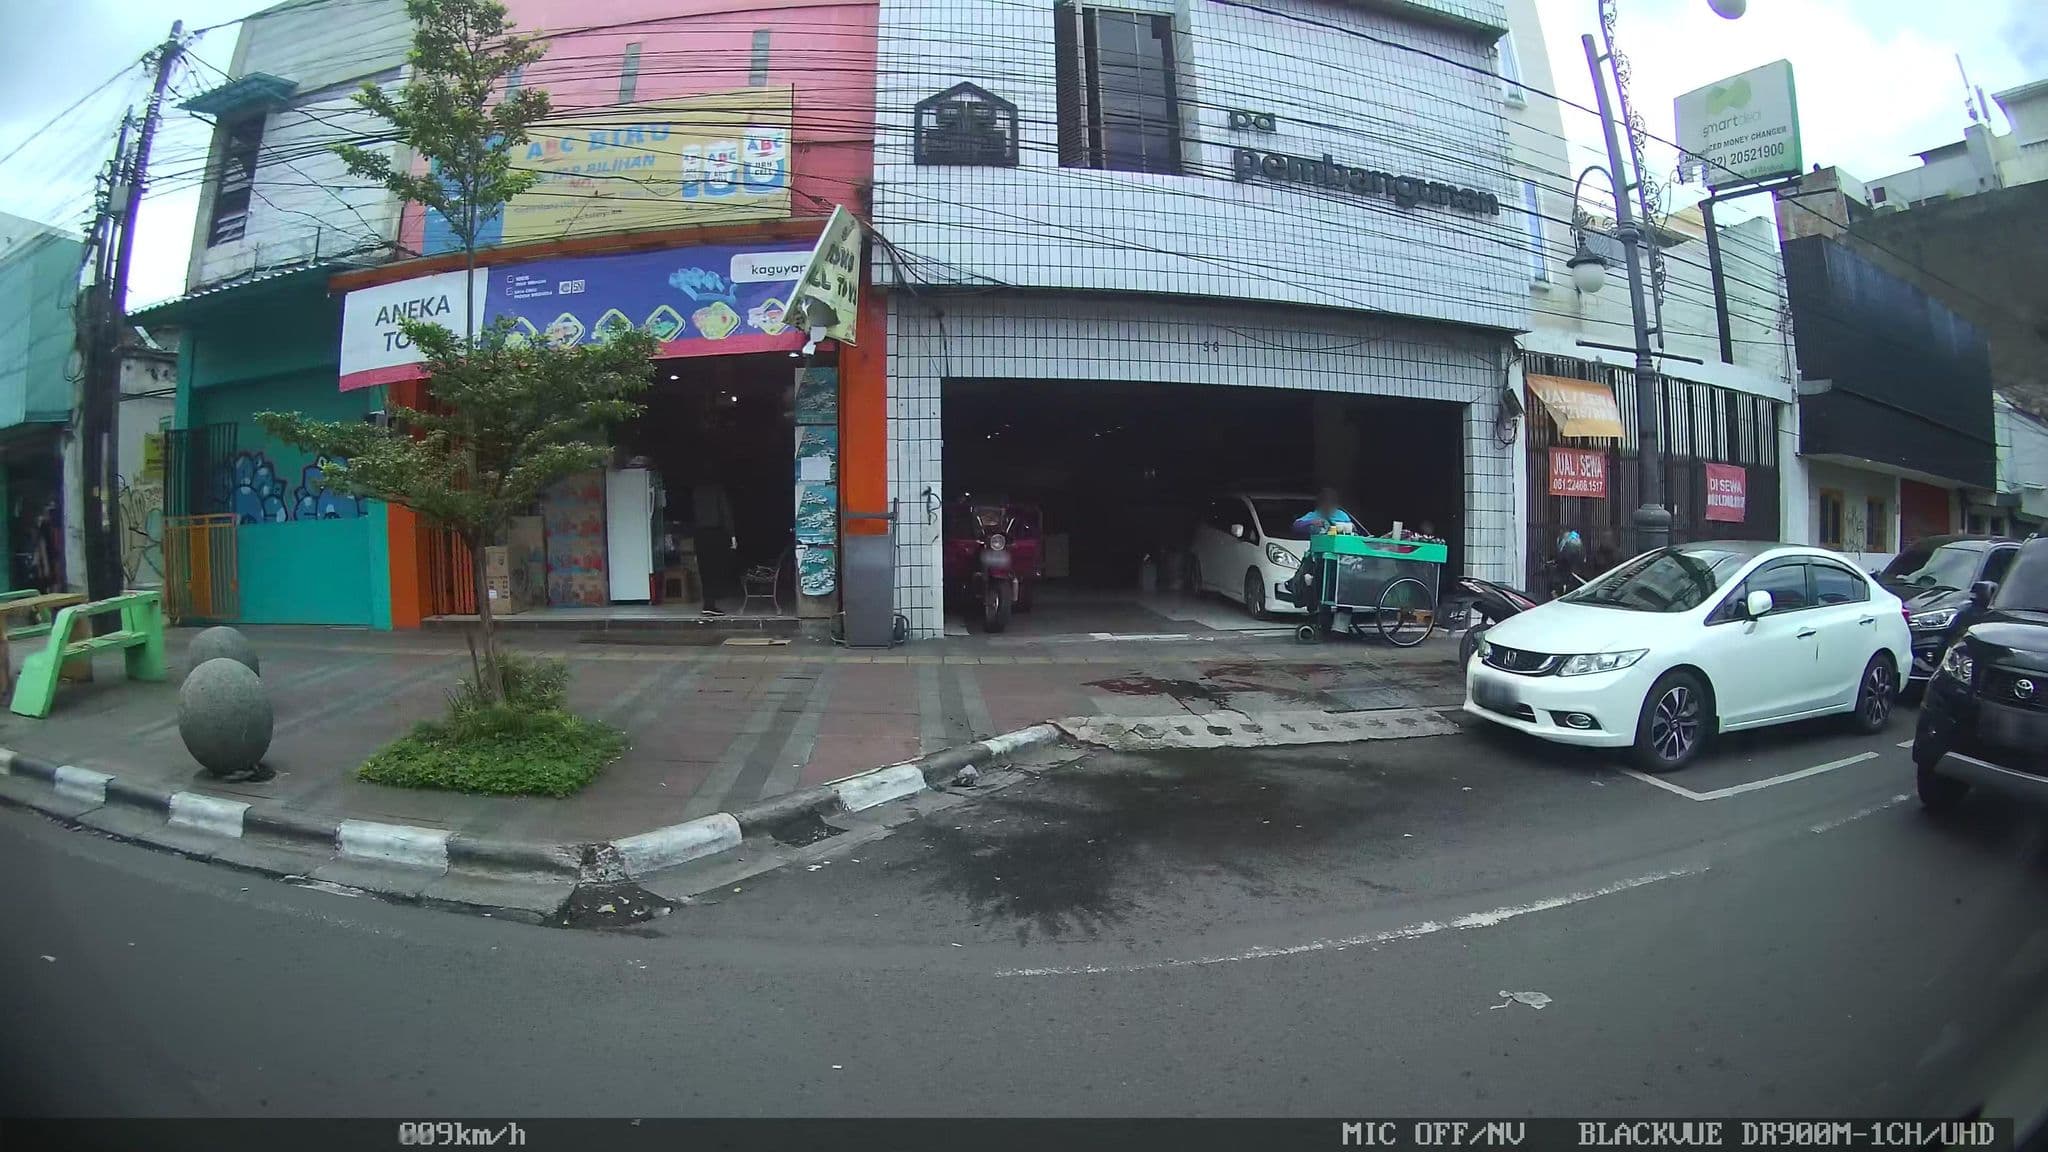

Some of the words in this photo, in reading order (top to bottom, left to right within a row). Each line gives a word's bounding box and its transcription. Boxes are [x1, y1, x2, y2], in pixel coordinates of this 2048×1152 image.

[526, 135, 574, 160] ABC
[1723, 136, 1749, 148] MONEY
[1751, 125, 1786, 141] CHANGER
[1730, 142, 1785, 165] 20521900
[375, 294, 451, 326] ANEKA
[383, 330, 412, 352] TO
[1553, 452, 1576, 476] JUAL
[1580, 454, 1603, 478] SEWA
[1711, 479, 1718, 491] DI
[1720, 479, 1743, 493] SEWA
